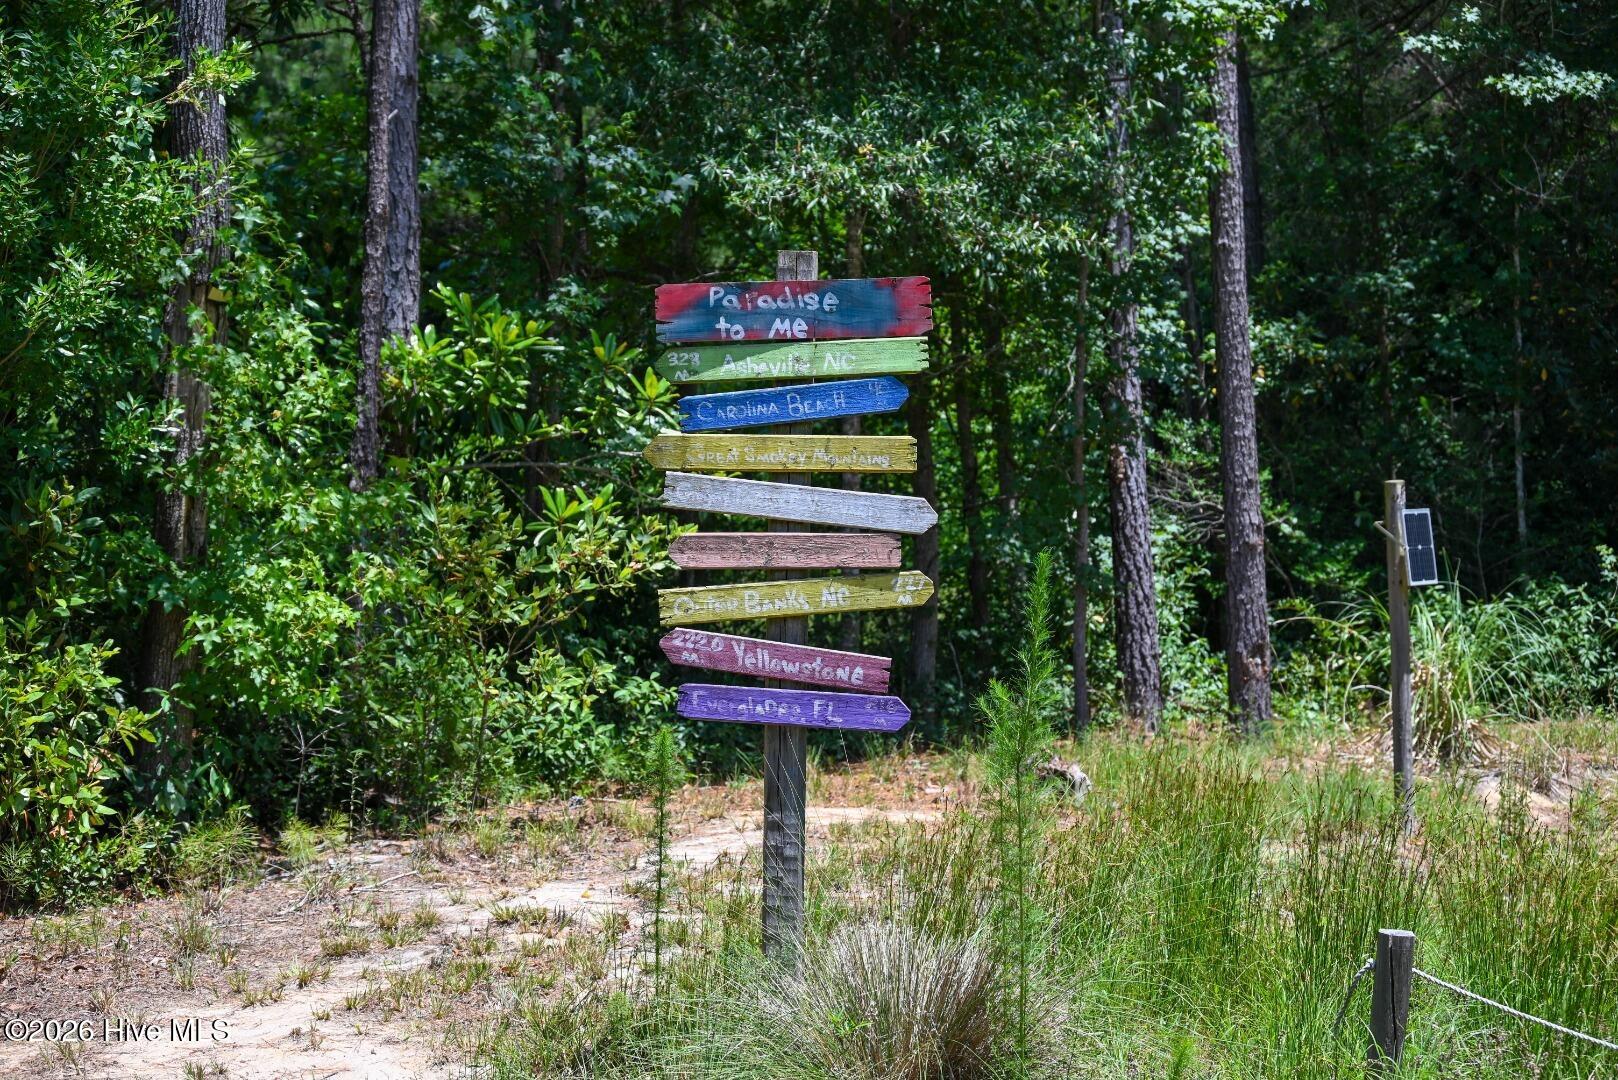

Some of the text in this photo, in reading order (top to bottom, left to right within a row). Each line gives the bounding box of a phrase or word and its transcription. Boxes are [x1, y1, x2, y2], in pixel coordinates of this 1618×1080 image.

[709, 286, 840, 312] Paradise
[715, 315, 746, 340] to
[823, 351, 857, 372] NC
[813, 700, 843, 723] FL
